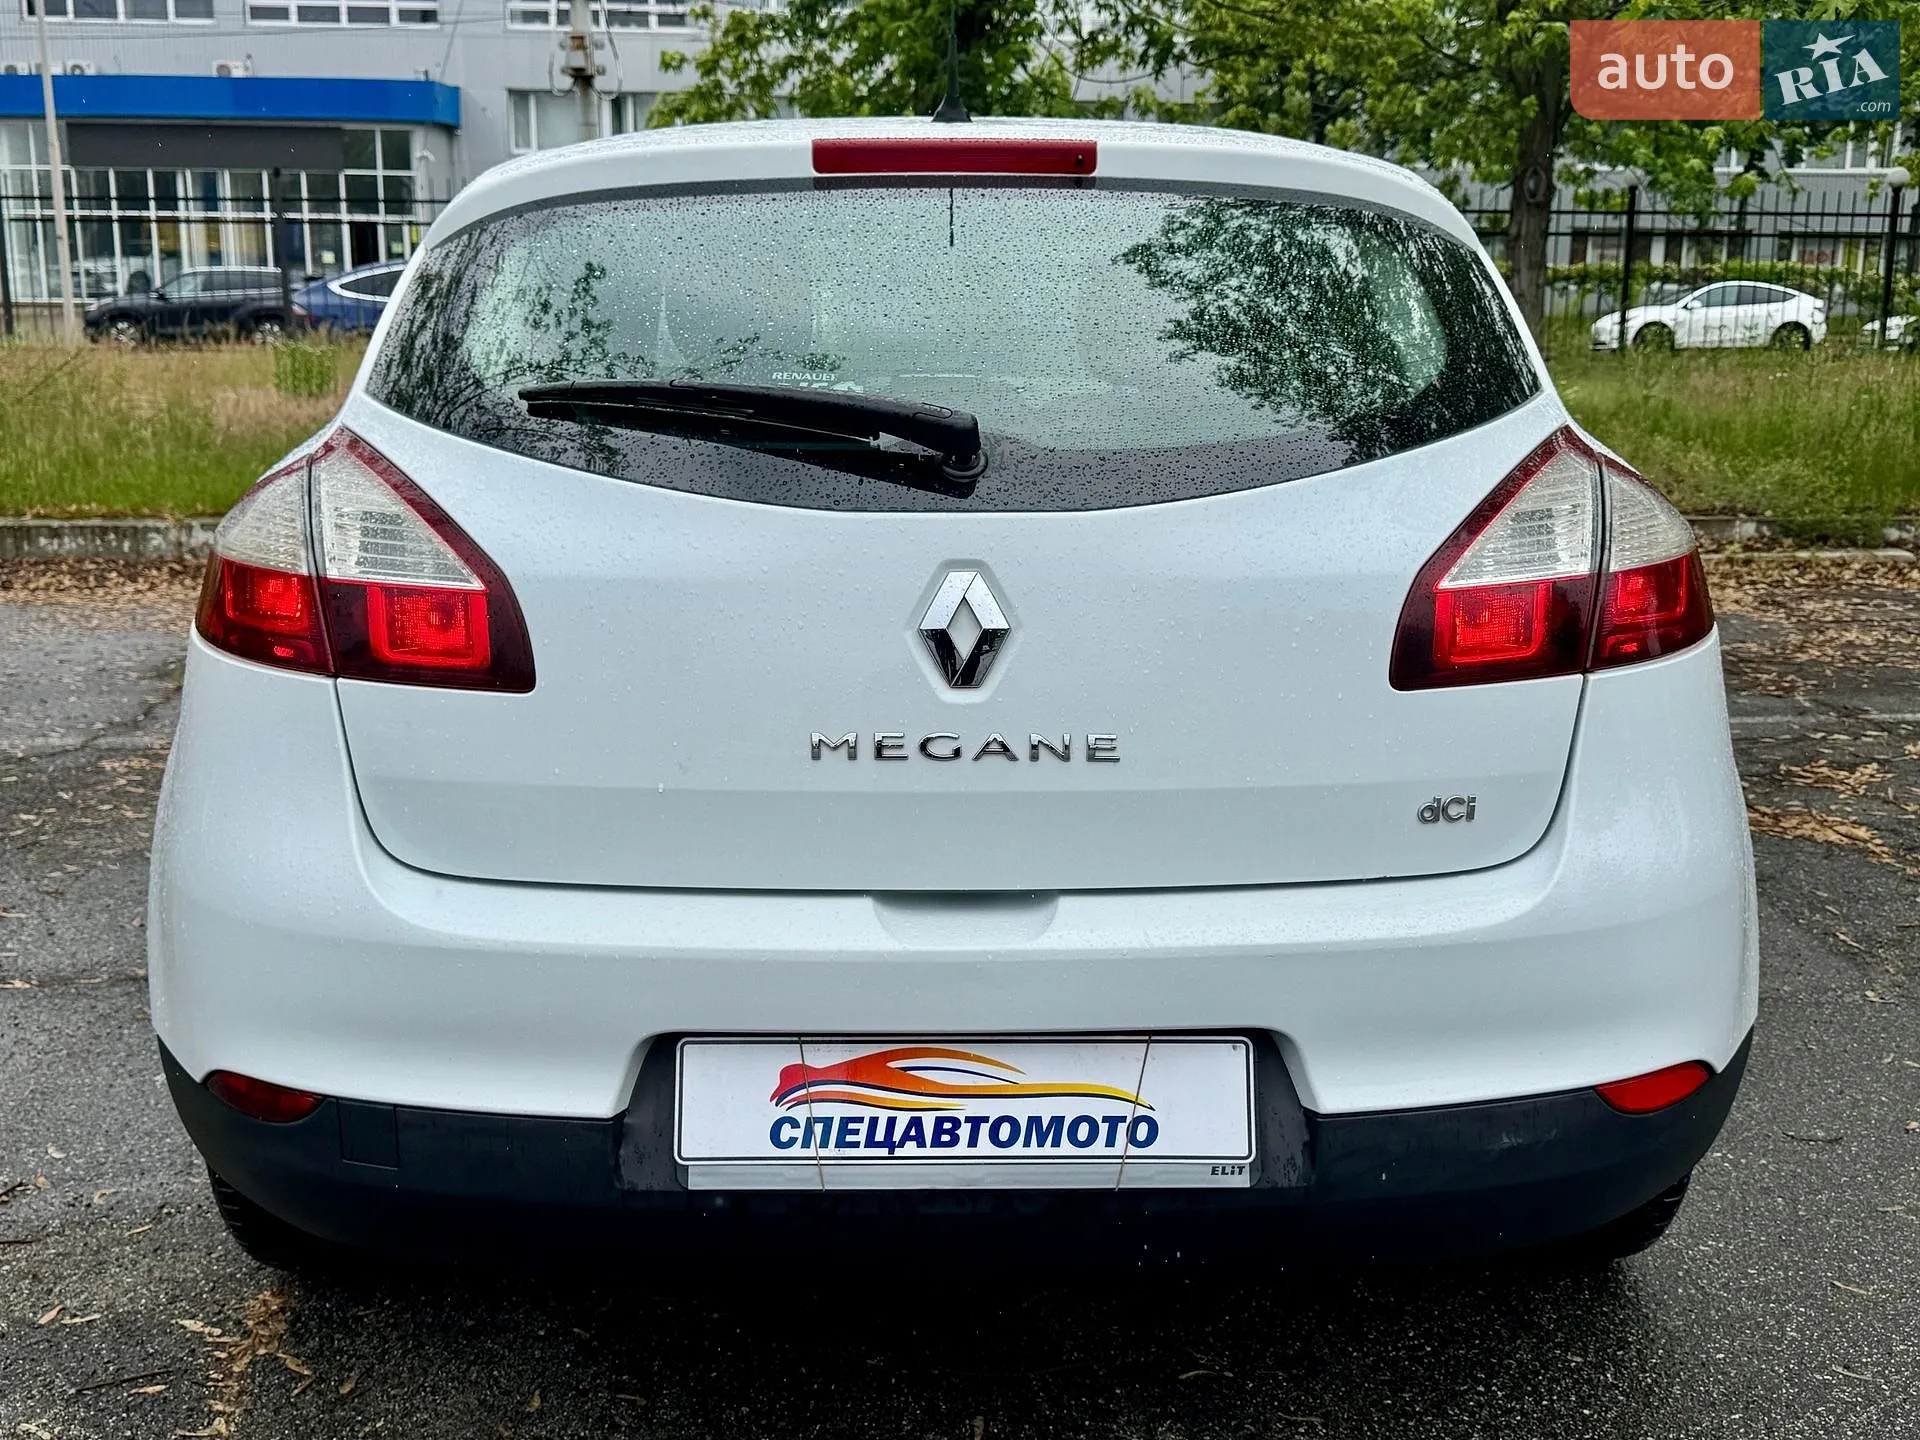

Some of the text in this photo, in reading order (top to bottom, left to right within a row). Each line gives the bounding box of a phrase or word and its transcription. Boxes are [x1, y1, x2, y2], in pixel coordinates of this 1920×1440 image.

[810, 731, 1121, 762] MEGANE
[1417, 795, 1477, 824] dCi
[769, 1114, 1159, 1155] СПЕЦАВТОМОТО
